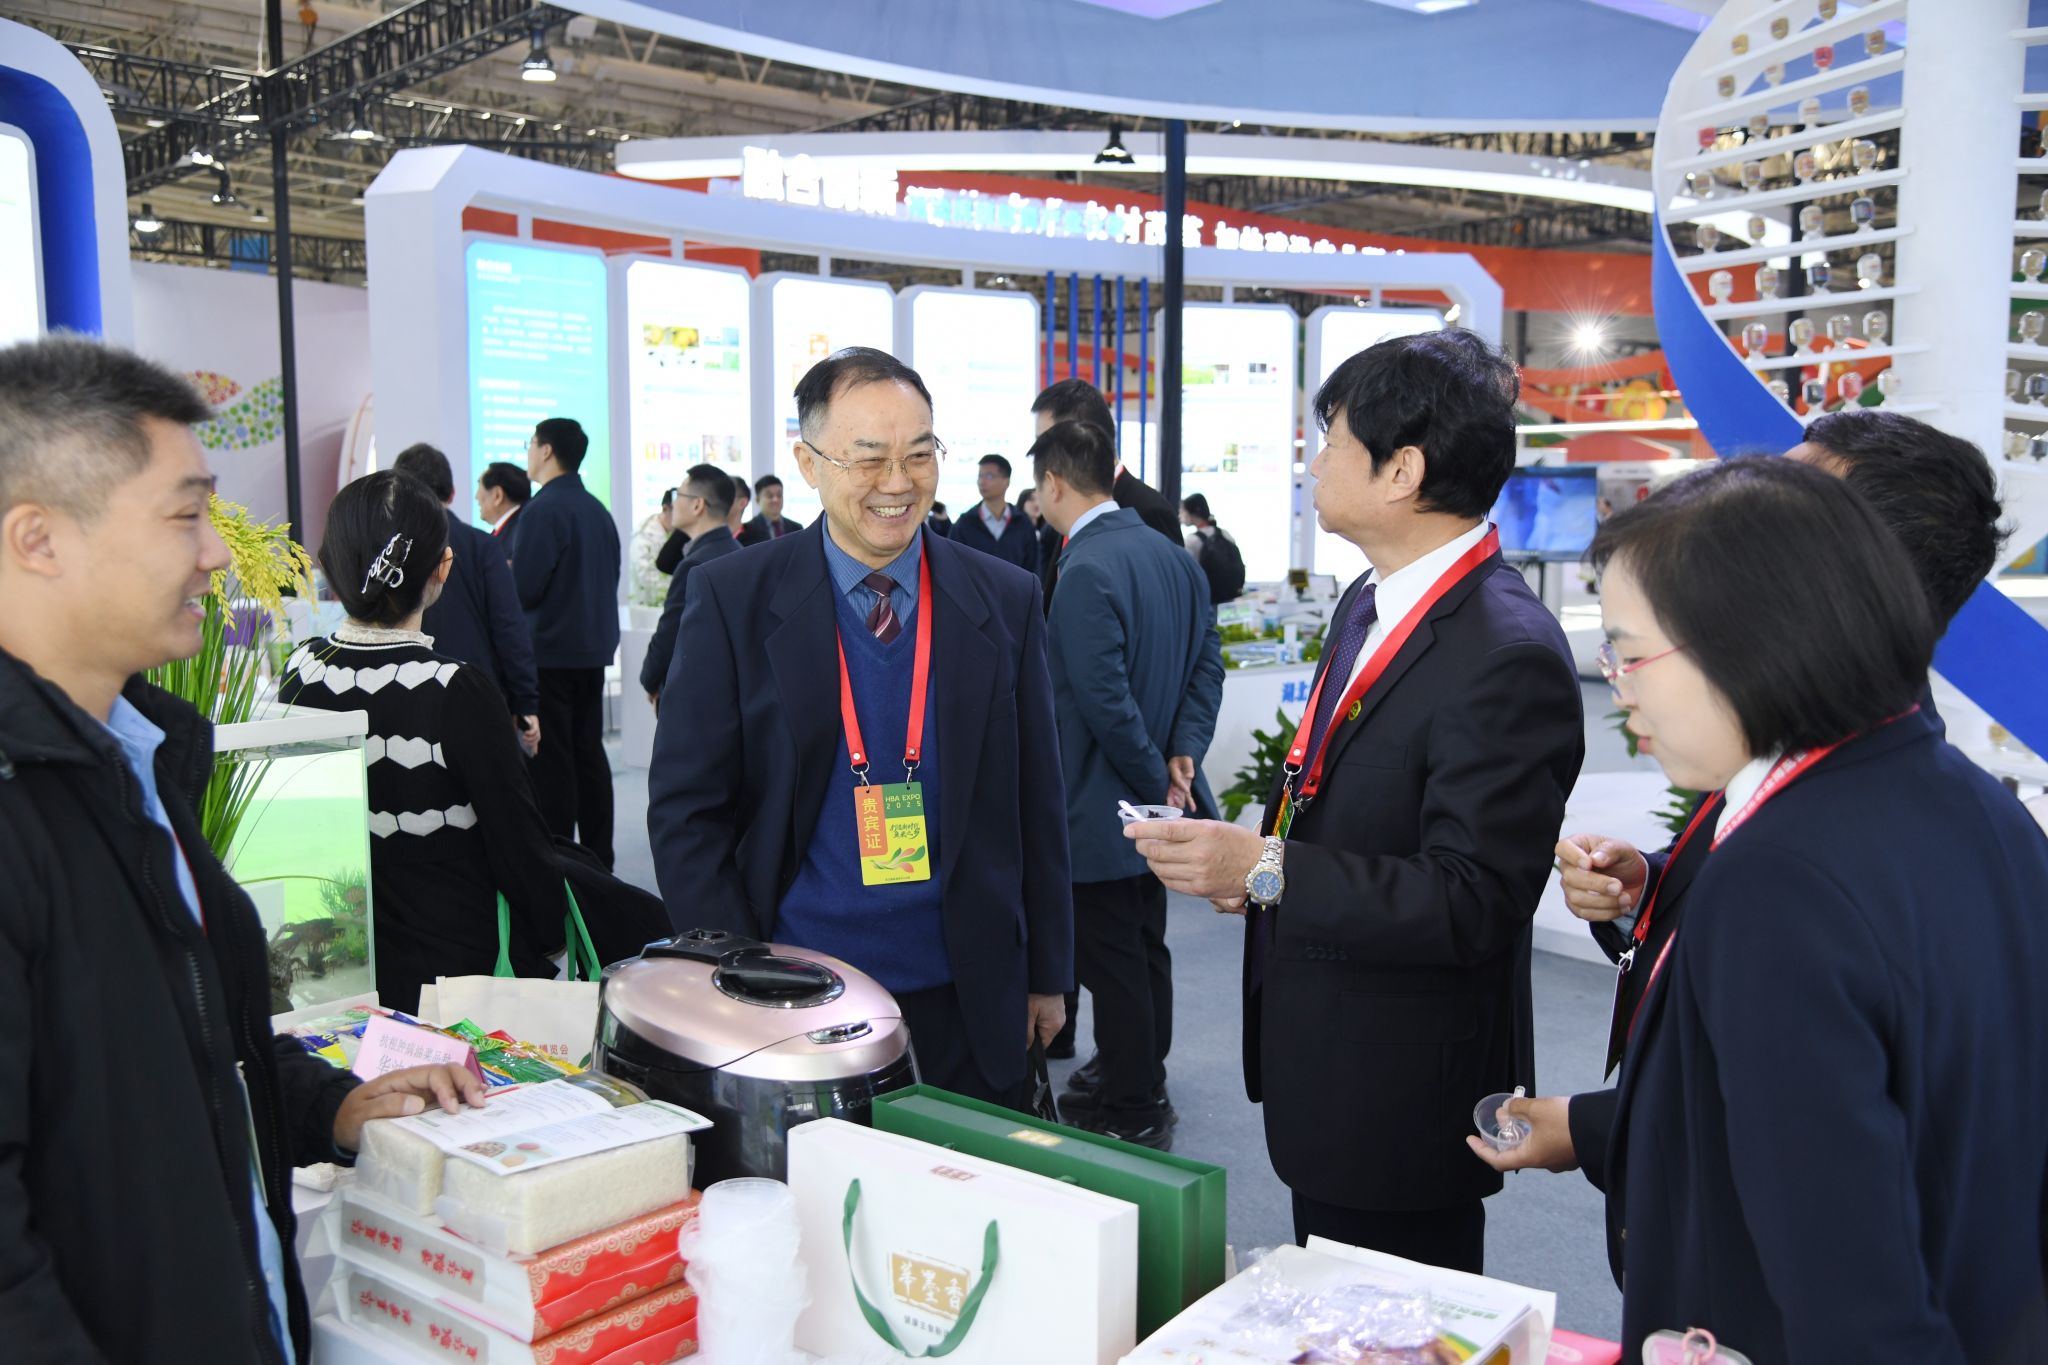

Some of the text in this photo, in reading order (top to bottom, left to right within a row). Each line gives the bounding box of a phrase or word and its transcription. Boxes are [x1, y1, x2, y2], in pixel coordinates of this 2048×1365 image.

[902, 793, 921, 801] EXPO
[886, 801, 921, 810] 2025
[862, 798, 882, 849] 贵宾证
